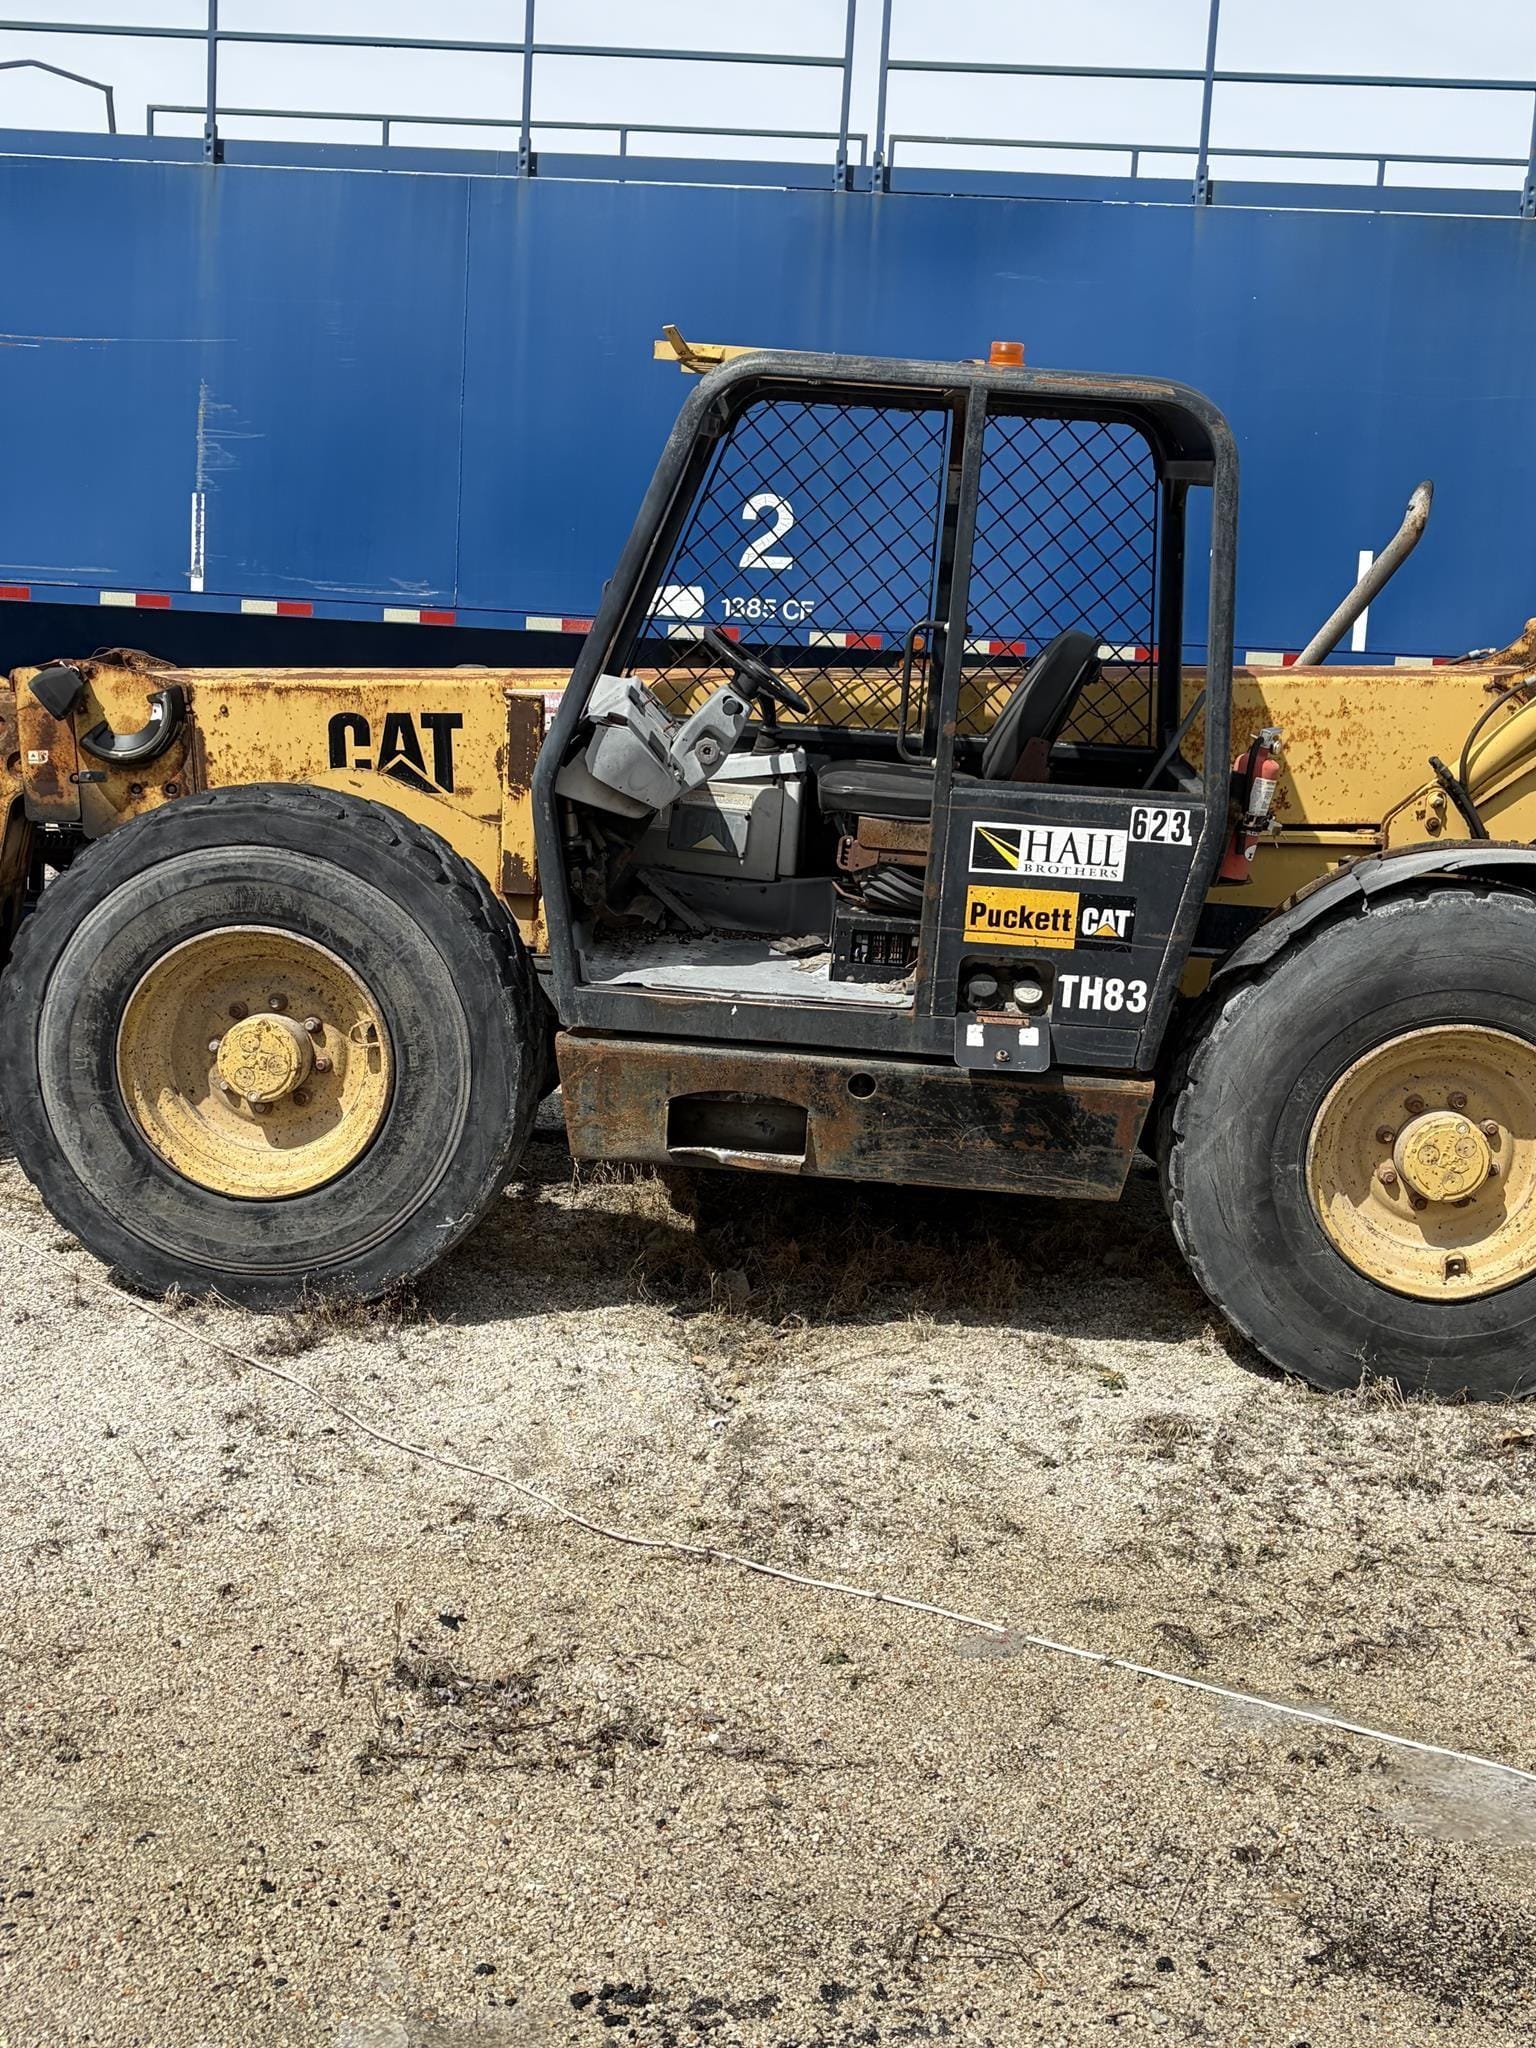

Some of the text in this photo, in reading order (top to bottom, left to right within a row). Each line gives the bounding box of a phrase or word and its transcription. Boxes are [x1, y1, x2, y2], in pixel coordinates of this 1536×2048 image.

[739, 493, 794, 570] 2
[721, 597, 815, 621] 1385 CF
[328, 712, 463, 794] CAT
[1132, 809, 1185, 842] 623
[1026, 830, 1120, 867] HALL
[1024, 864, 1118, 879] BROTHERS
[970, 901, 1132, 938] Puckett CAT
[1058, 974, 1148, 1013] TH83
